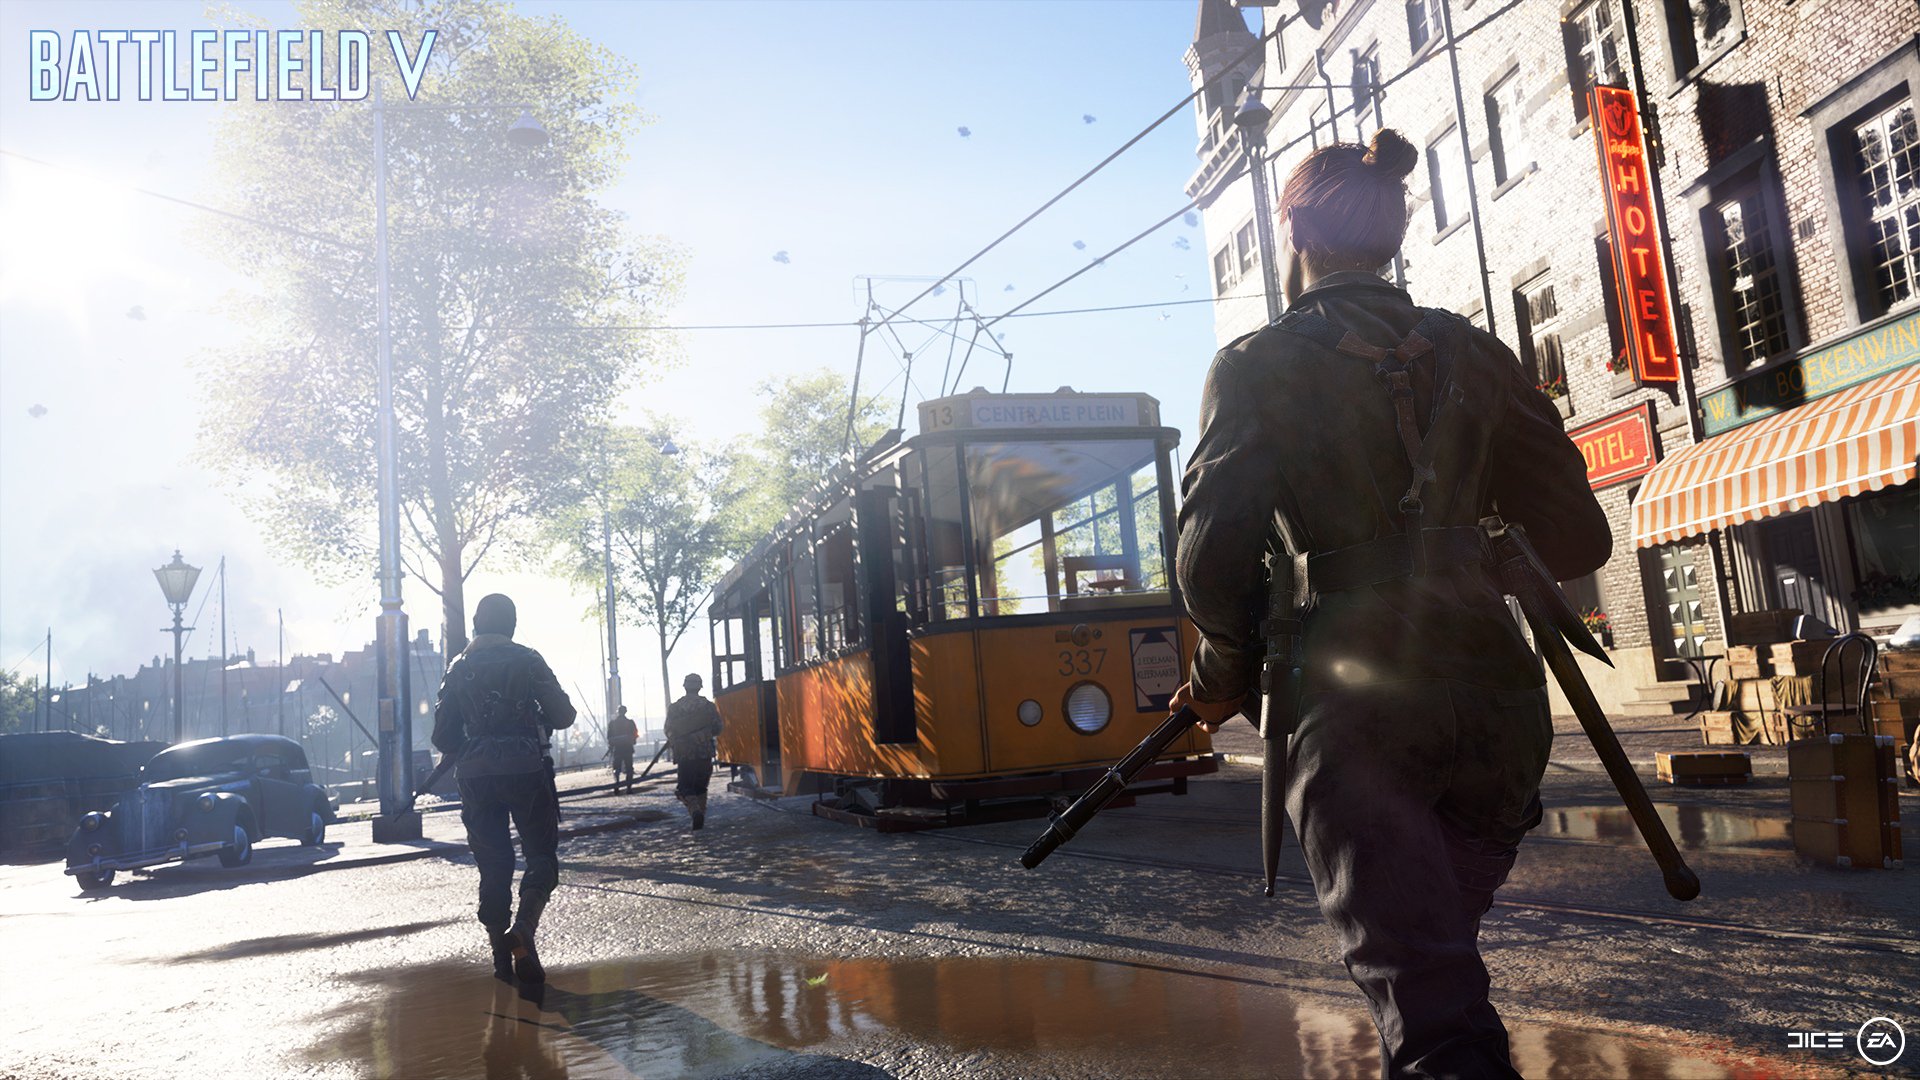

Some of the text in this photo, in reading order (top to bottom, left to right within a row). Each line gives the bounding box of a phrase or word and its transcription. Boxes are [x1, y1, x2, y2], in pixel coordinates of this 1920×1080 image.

[1618, 164, 1667, 364] HOTEL
[1776, 317, 1920, 398] BOEKENWIN
[929, 404, 1125, 428] 13 CENTRALE PLEIN
[1575, 431, 1635, 473] OTEL
[1058, 649, 1107, 677] 337
